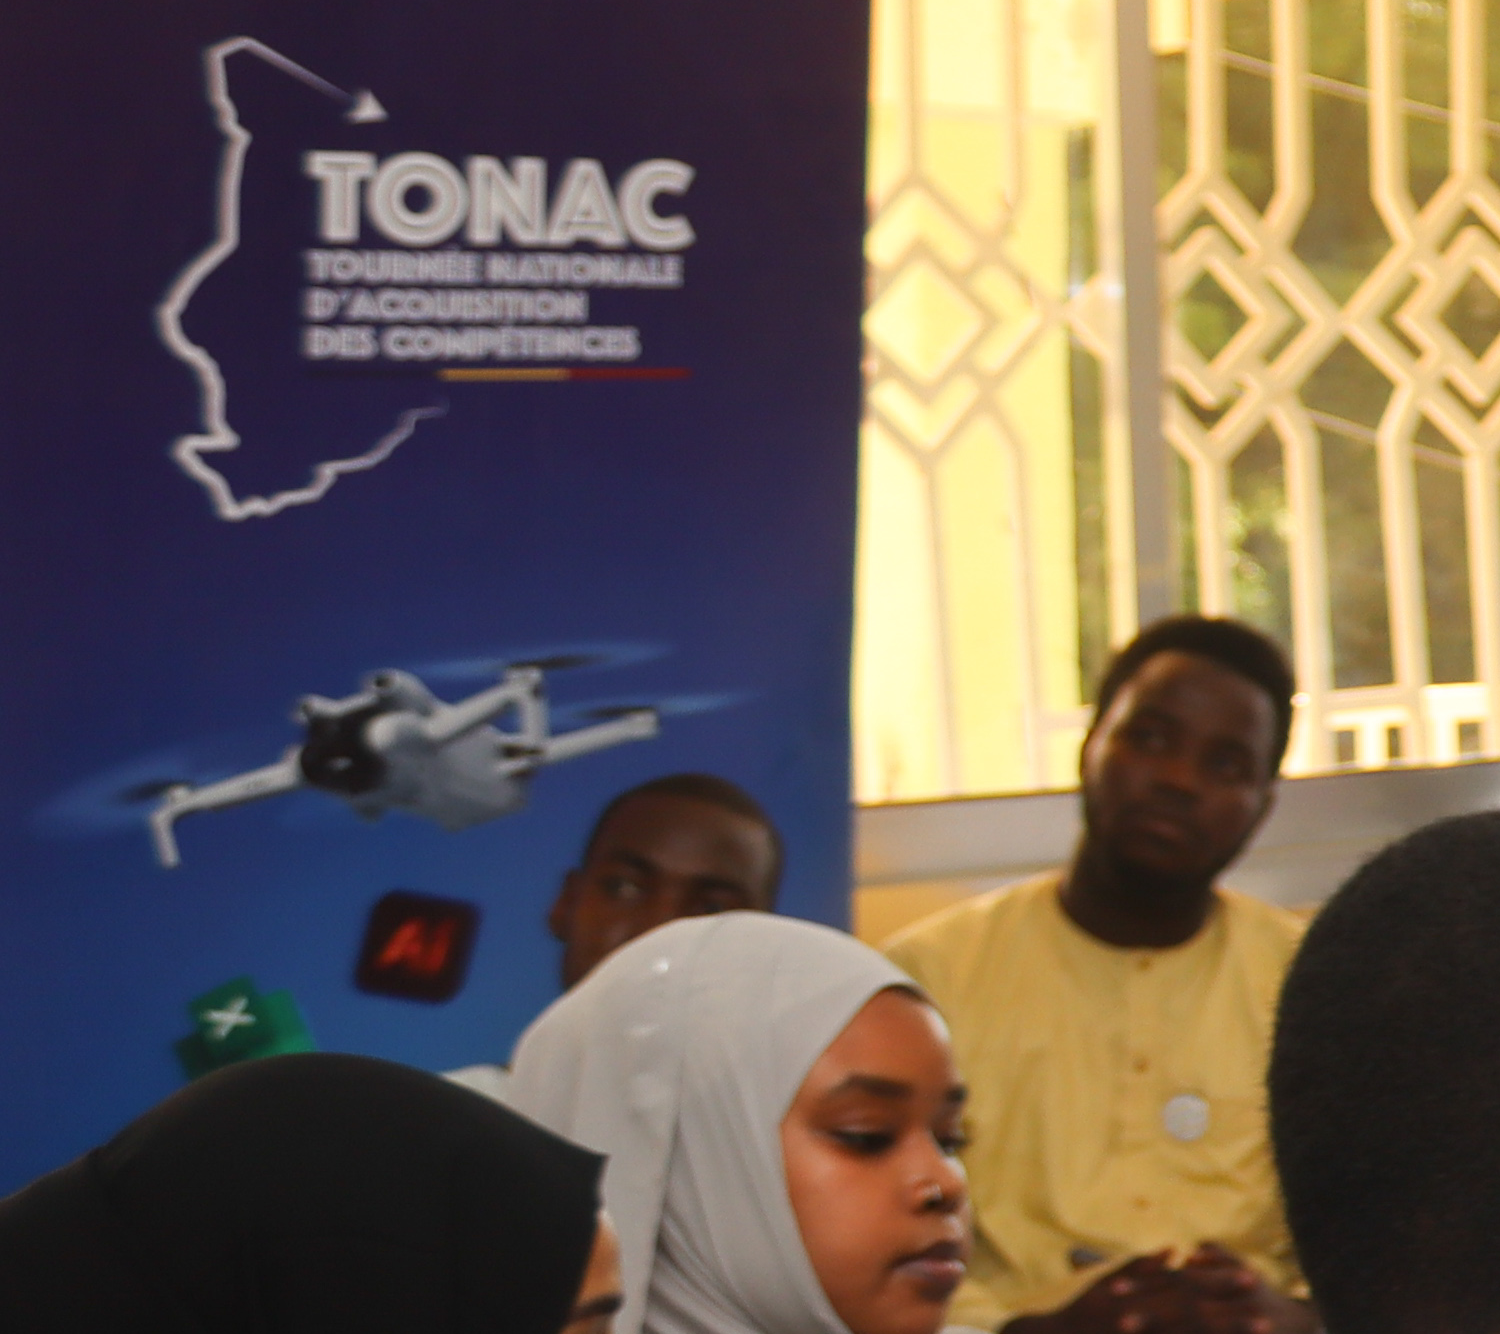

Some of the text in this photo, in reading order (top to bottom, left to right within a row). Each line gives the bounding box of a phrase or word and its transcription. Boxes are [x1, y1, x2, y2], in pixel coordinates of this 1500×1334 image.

[304, 149, 697, 252] TONAC
[485, 250, 685, 289] NATIONALE
[305, 324, 379, 362] DES
